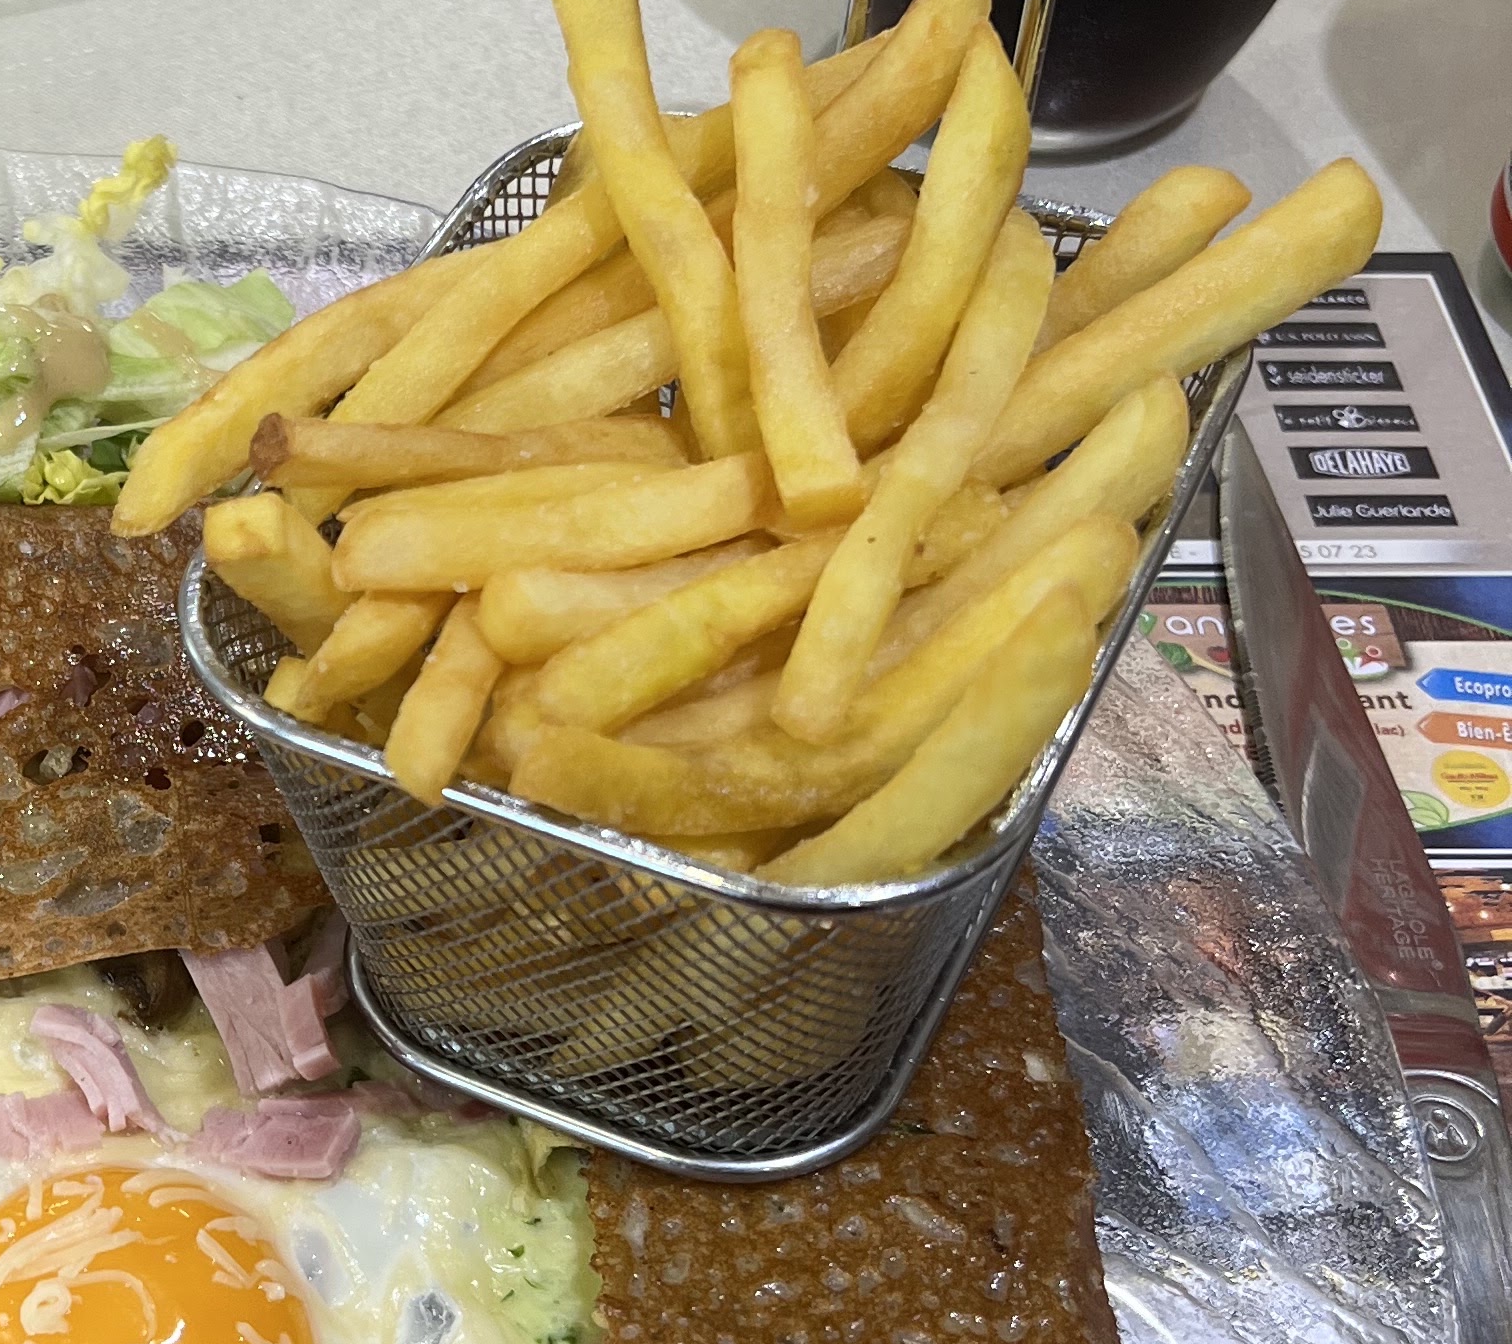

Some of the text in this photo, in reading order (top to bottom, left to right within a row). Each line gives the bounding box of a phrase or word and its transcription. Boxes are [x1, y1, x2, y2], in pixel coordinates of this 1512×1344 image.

[1314, 450, 1409, 476] DELAHAYE
[1313, 502, 1452, 519] Julie Guerlande
[1317, 544, 1343, 559] 07
[1348, 544, 1378, 559] 23
